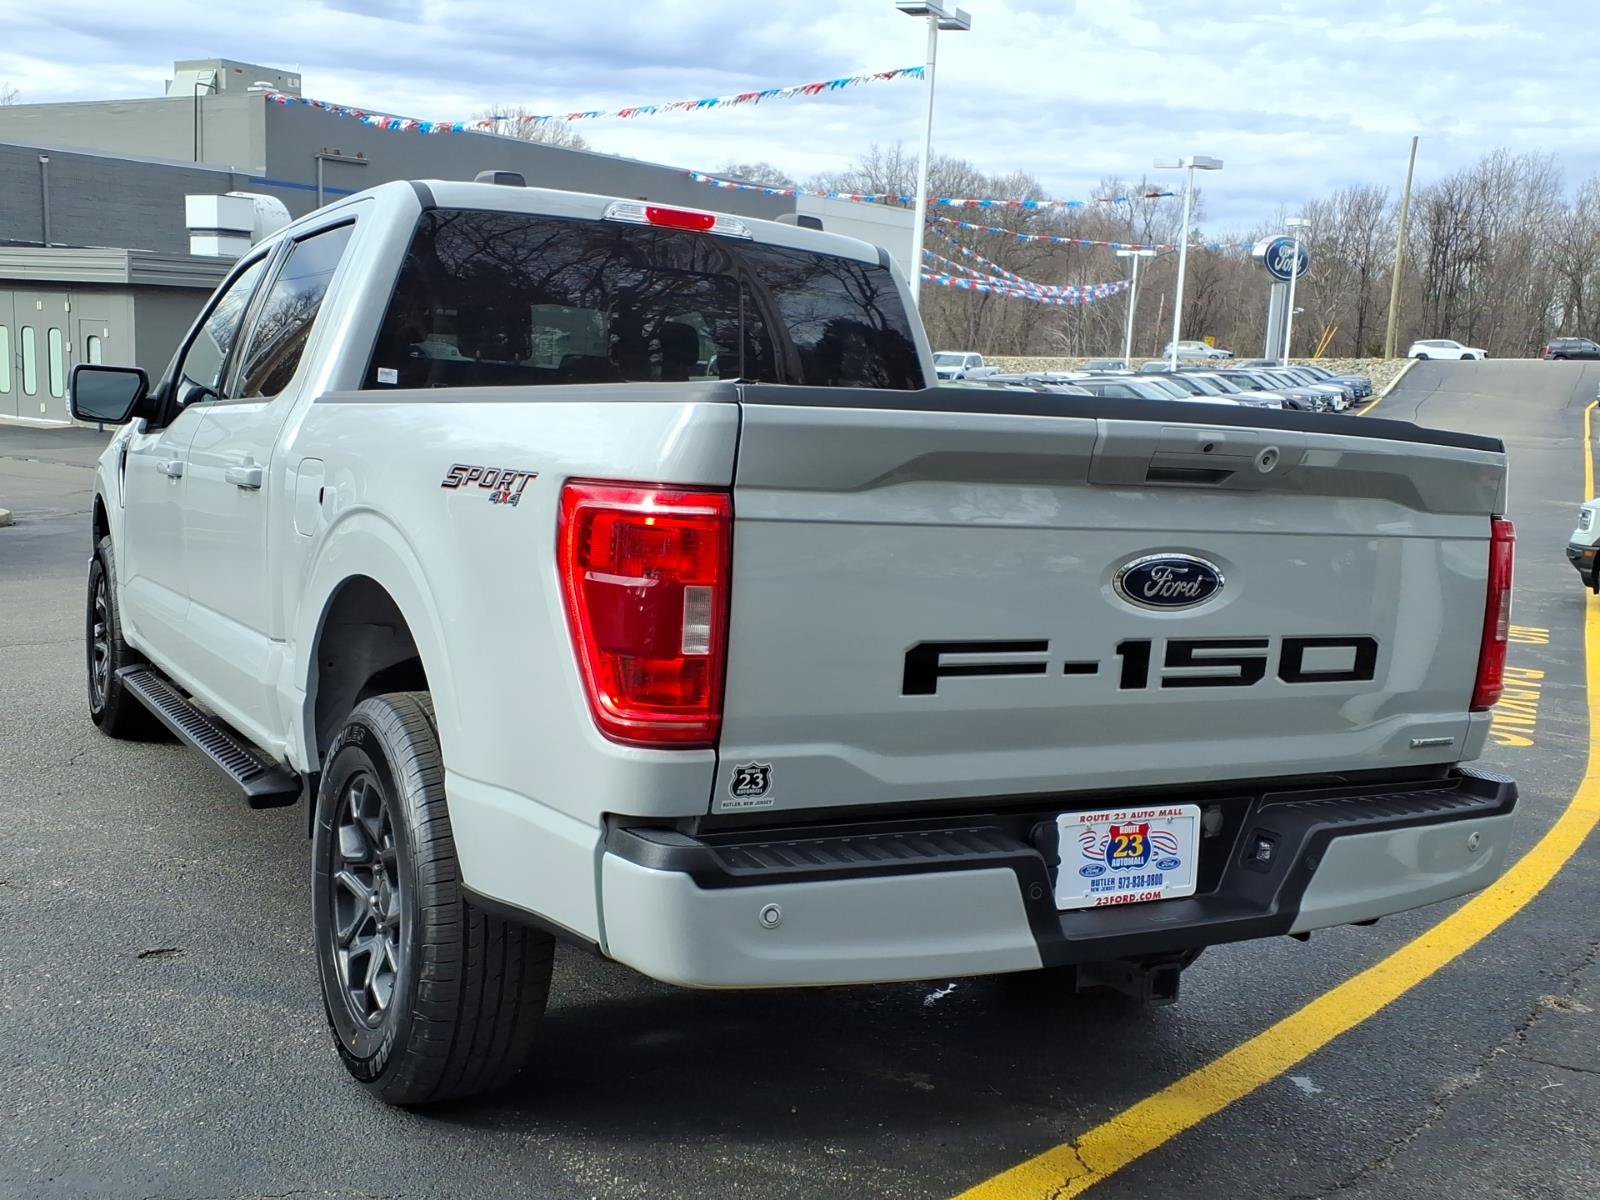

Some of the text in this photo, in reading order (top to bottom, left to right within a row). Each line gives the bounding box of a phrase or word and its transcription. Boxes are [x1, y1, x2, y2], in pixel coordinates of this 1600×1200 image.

[441, 464, 539, 492] SPORT
[1143, 566, 1204, 597] Ford
[902, 636, 1378, 696] F-150
[738, 773, 763, 789] 23
[1080, 808, 1183, 822] ROUTE 23 AUTO MALL
[1119, 825, 1140, 834] ROUTE
[1113, 834, 1144, 858] 23
[1111, 857, 1144, 867] AUTOMALL
[1090, 878, 1116, 887] BUTLER
[1096, 891, 1162, 905] 23FORD.COM
